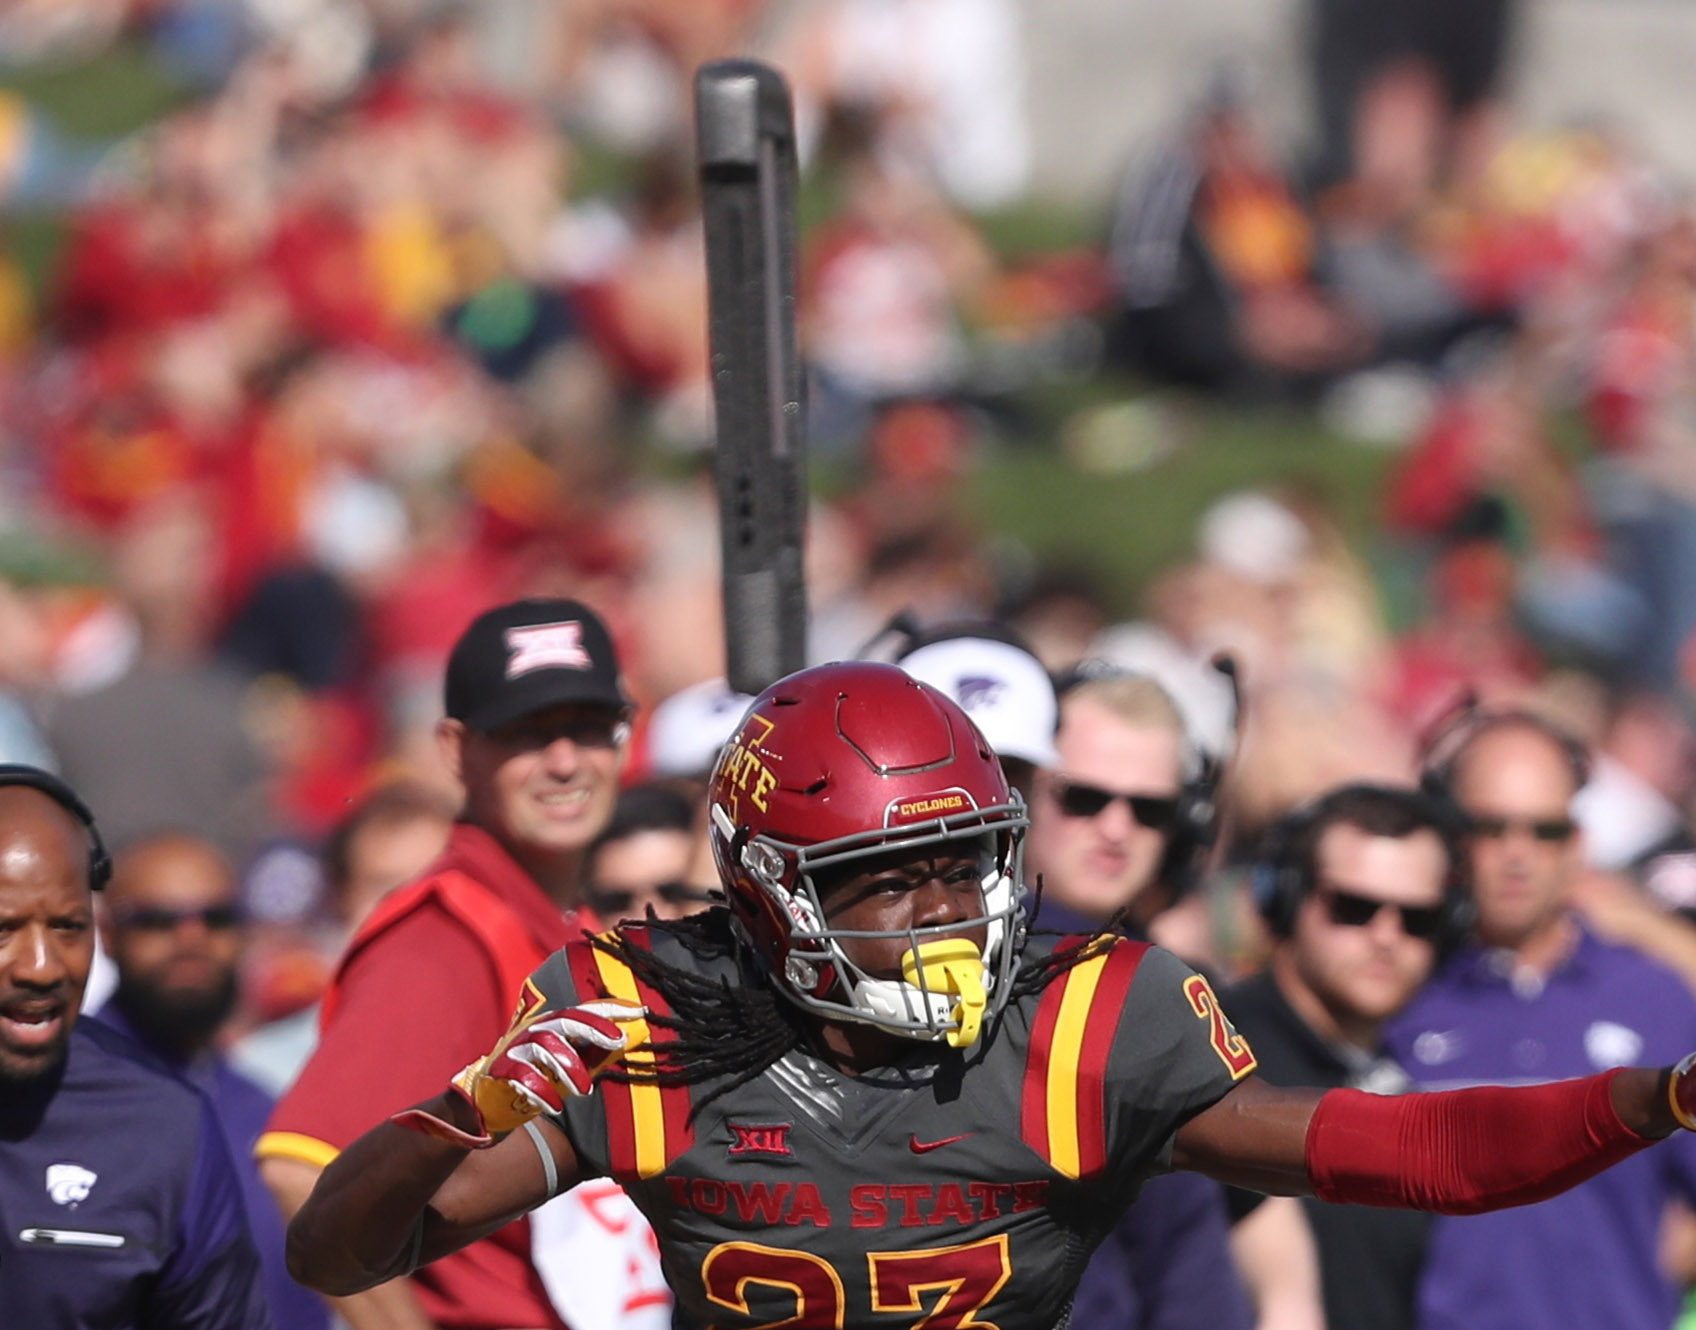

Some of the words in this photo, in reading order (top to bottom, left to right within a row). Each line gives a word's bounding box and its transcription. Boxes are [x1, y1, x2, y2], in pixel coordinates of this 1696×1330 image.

[900, 795, 963, 816] CYCLONES
[1182, 973, 1258, 1081] 2
[727, 1123, 793, 1157] XII
[664, 1174, 832, 1228] IOWA
[848, 1179, 1051, 1229] STATE
